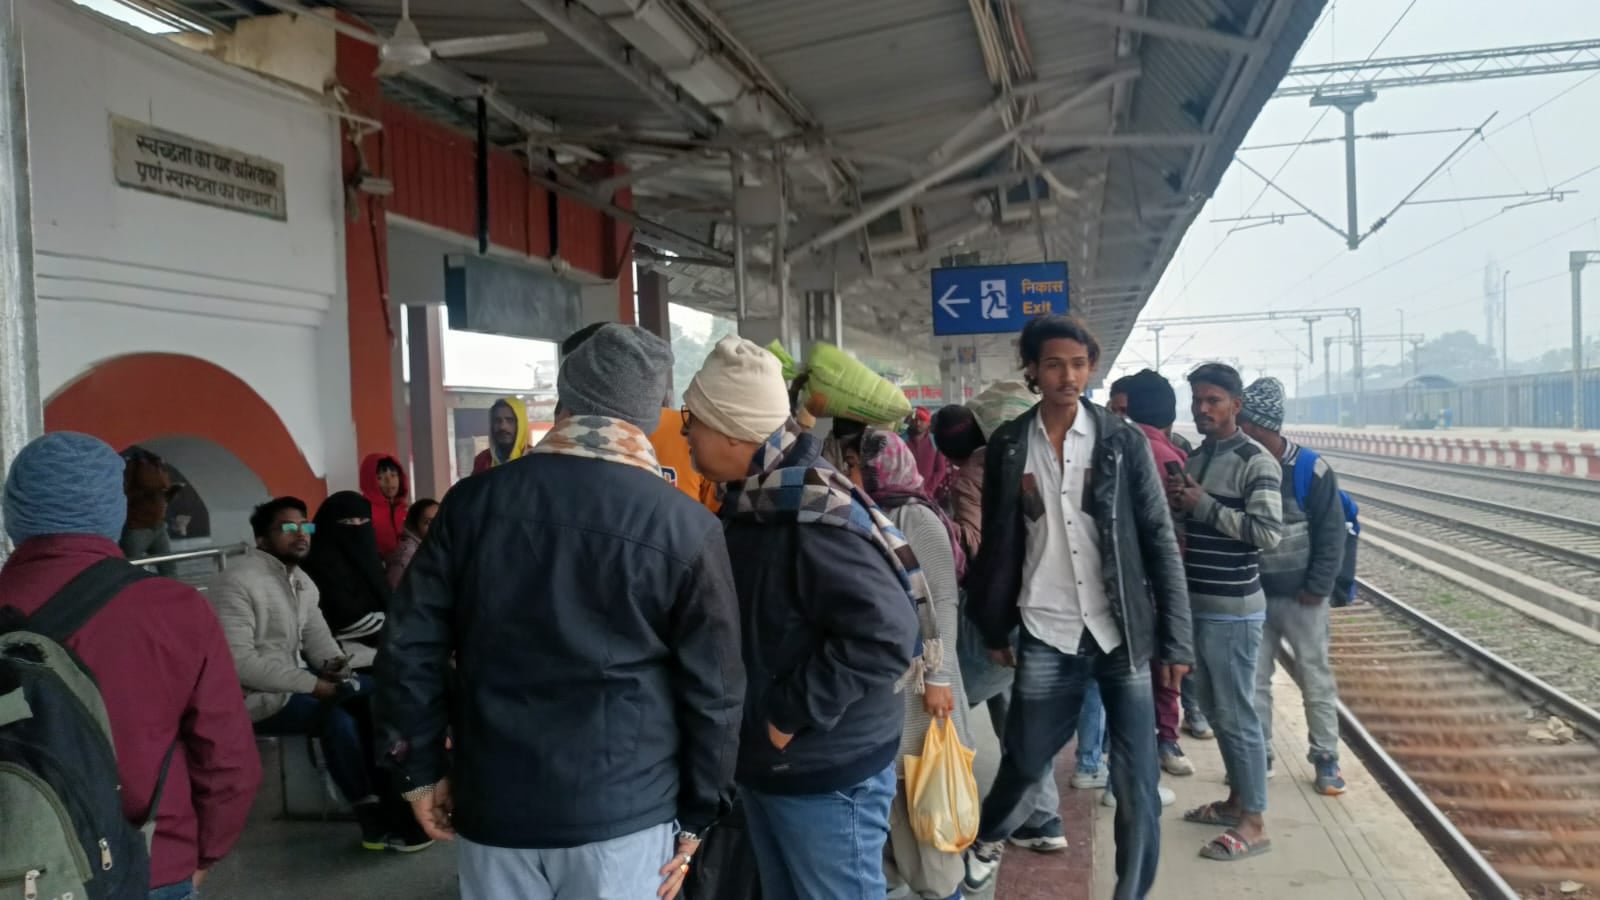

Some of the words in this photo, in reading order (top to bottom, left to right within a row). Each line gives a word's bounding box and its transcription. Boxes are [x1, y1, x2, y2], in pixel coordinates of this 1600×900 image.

[194, 147, 211, 170] का
[1021, 279, 1063, 294] निकास
[1023, 301, 1052, 314] Exit
